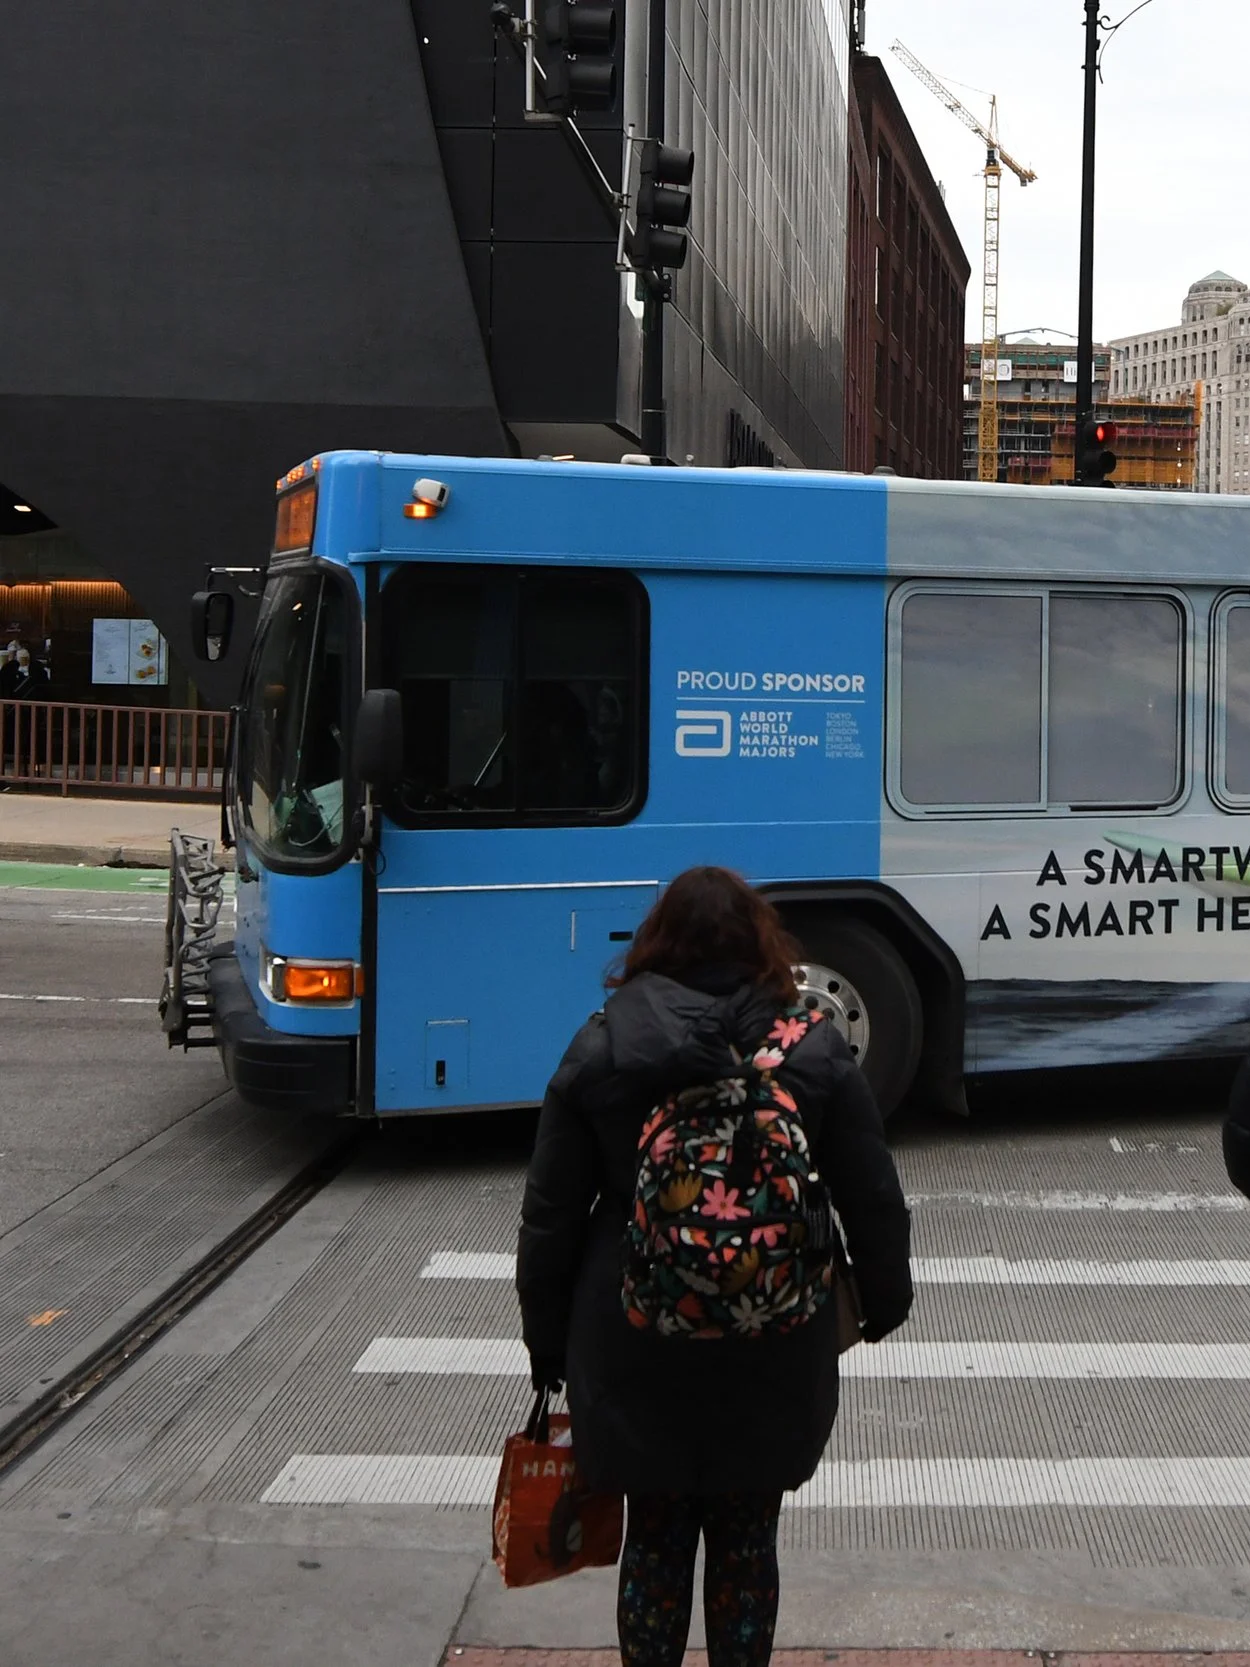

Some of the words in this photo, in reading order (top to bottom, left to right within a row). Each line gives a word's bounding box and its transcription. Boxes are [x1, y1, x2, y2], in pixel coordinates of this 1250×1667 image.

[677, 671, 757, 690] PROUD
[761, 672, 865, 693] SPONSOR
[739, 711, 793, 723] ABBOTT
[739, 723, 789, 734] WORLD
[739, 735, 819, 746] MARATHON
[739, 747, 796, 758] MAJORS
[1036, 850, 1067, 886] A
[980, 904, 1012, 941] A
[1029, 899, 1179, 939] SMART
